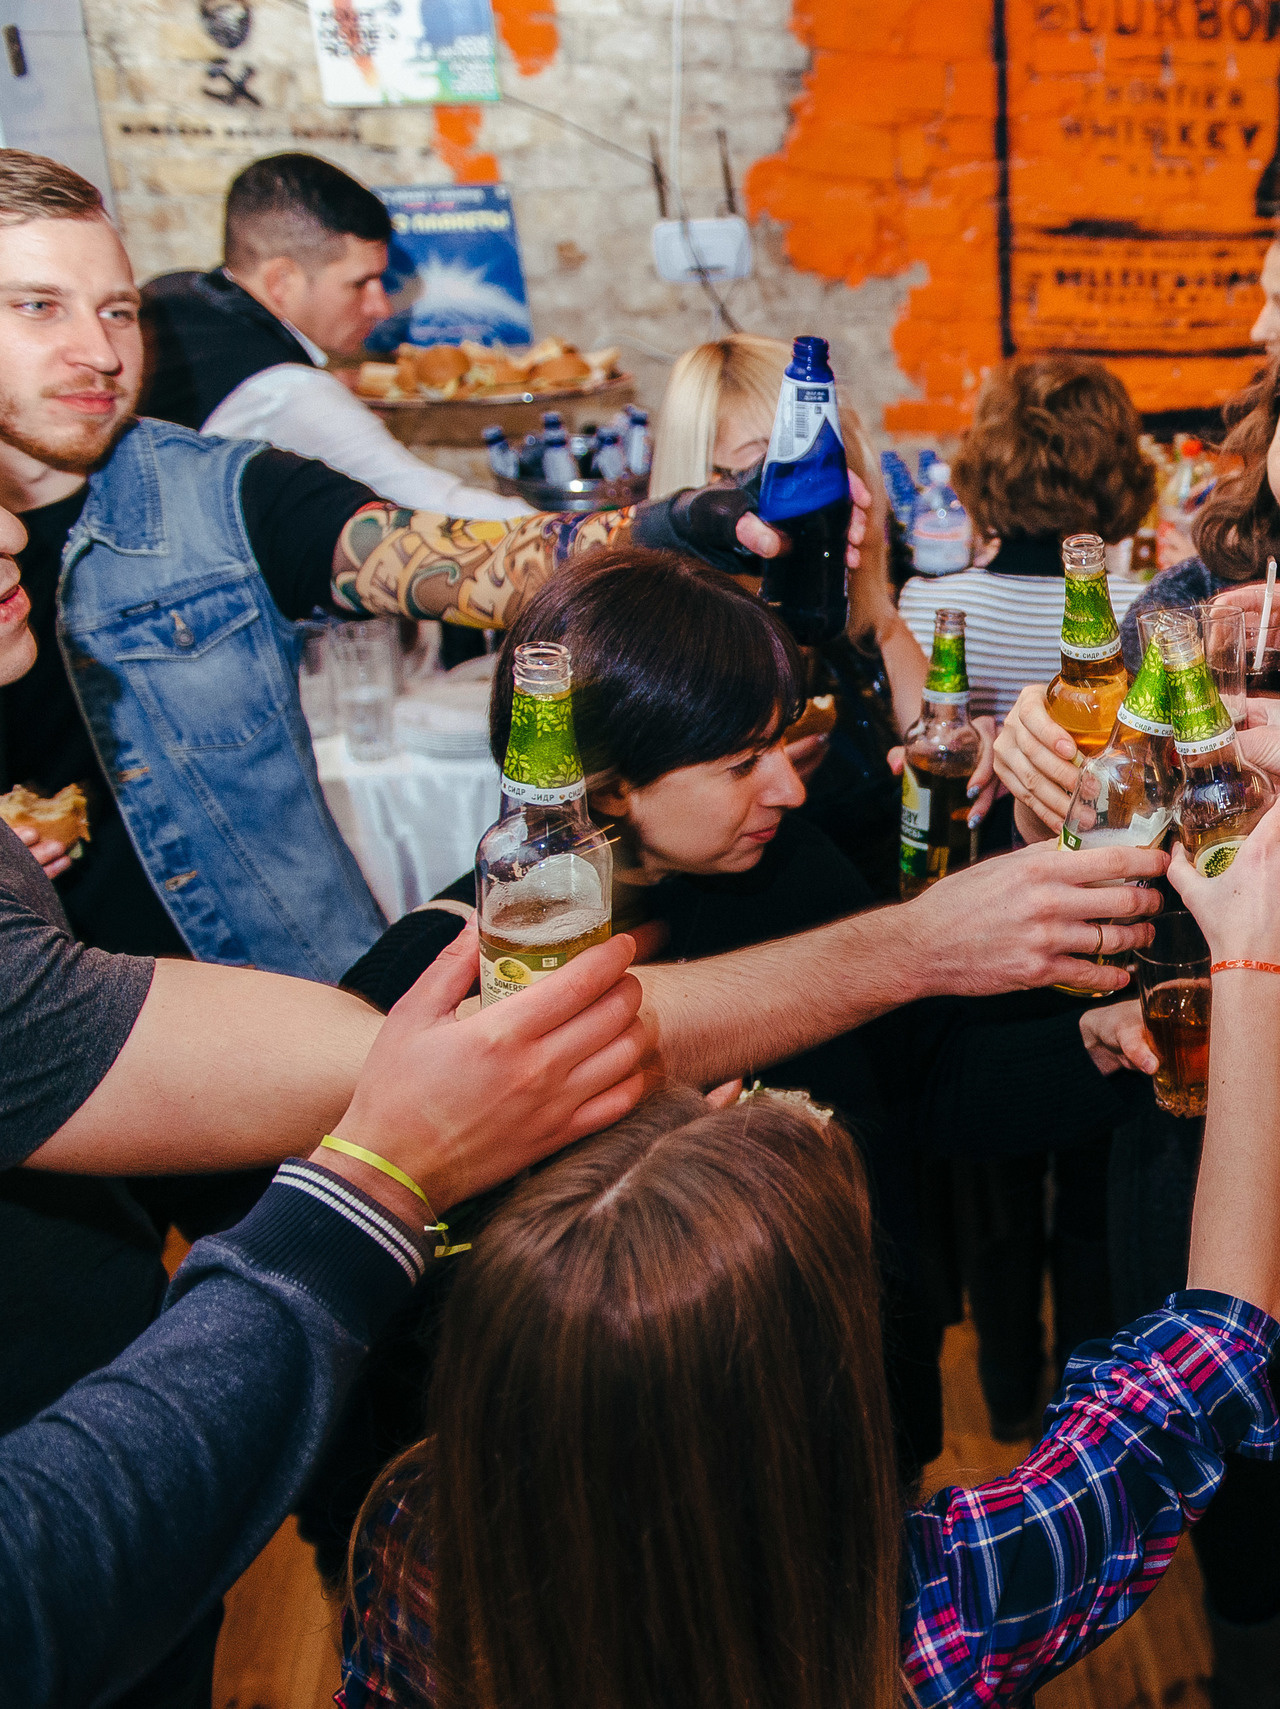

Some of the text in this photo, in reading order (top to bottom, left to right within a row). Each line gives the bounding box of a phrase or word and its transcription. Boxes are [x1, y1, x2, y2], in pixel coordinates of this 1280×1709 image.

[1134, 722, 1152, 732] СИДР
[1199, 743, 1217, 753] СИДР
[1225, 732, 1236, 743] СИД
[507, 785, 526, 796] СИДР
